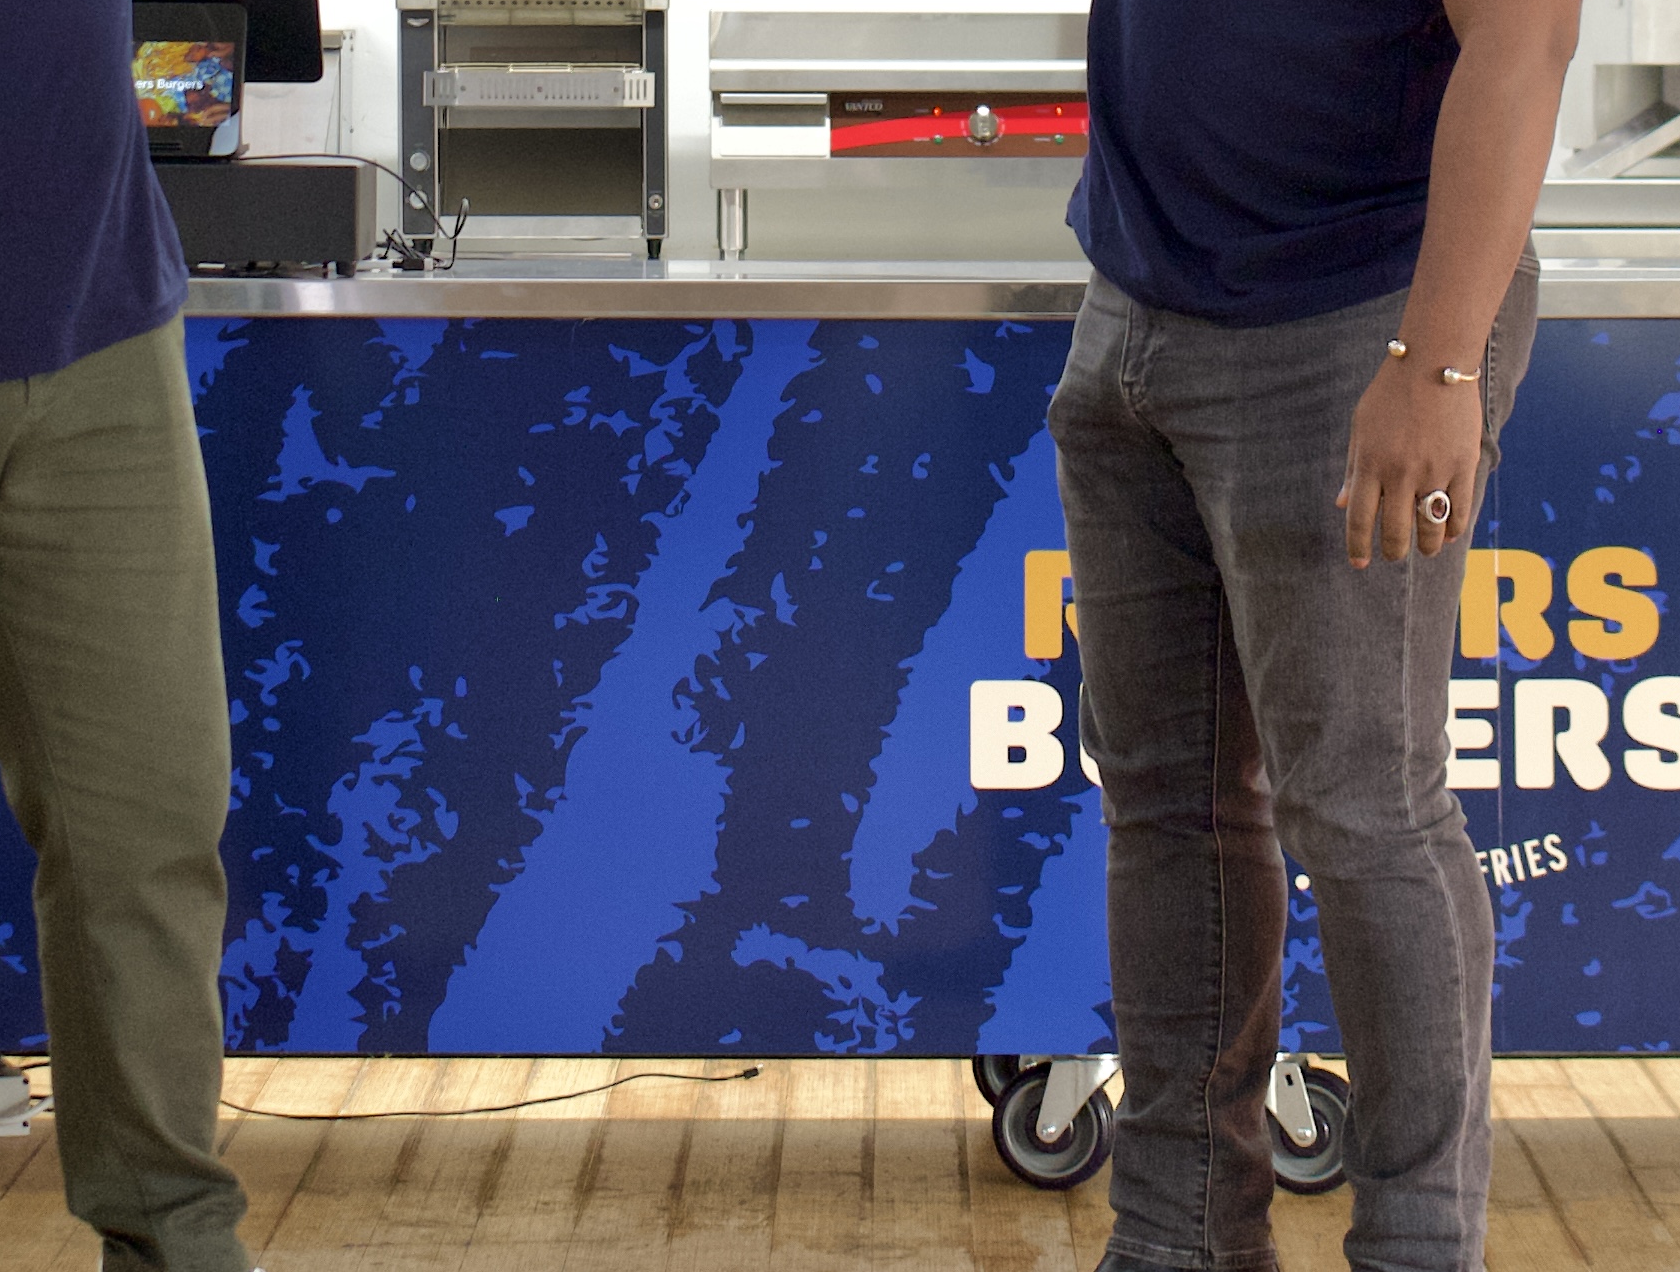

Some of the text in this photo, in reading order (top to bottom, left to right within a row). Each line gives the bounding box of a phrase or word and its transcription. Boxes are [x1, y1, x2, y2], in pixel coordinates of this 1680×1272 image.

[134, 78, 204, 92] ers Burgers
[1025, 546, 1661, 661] RRS
